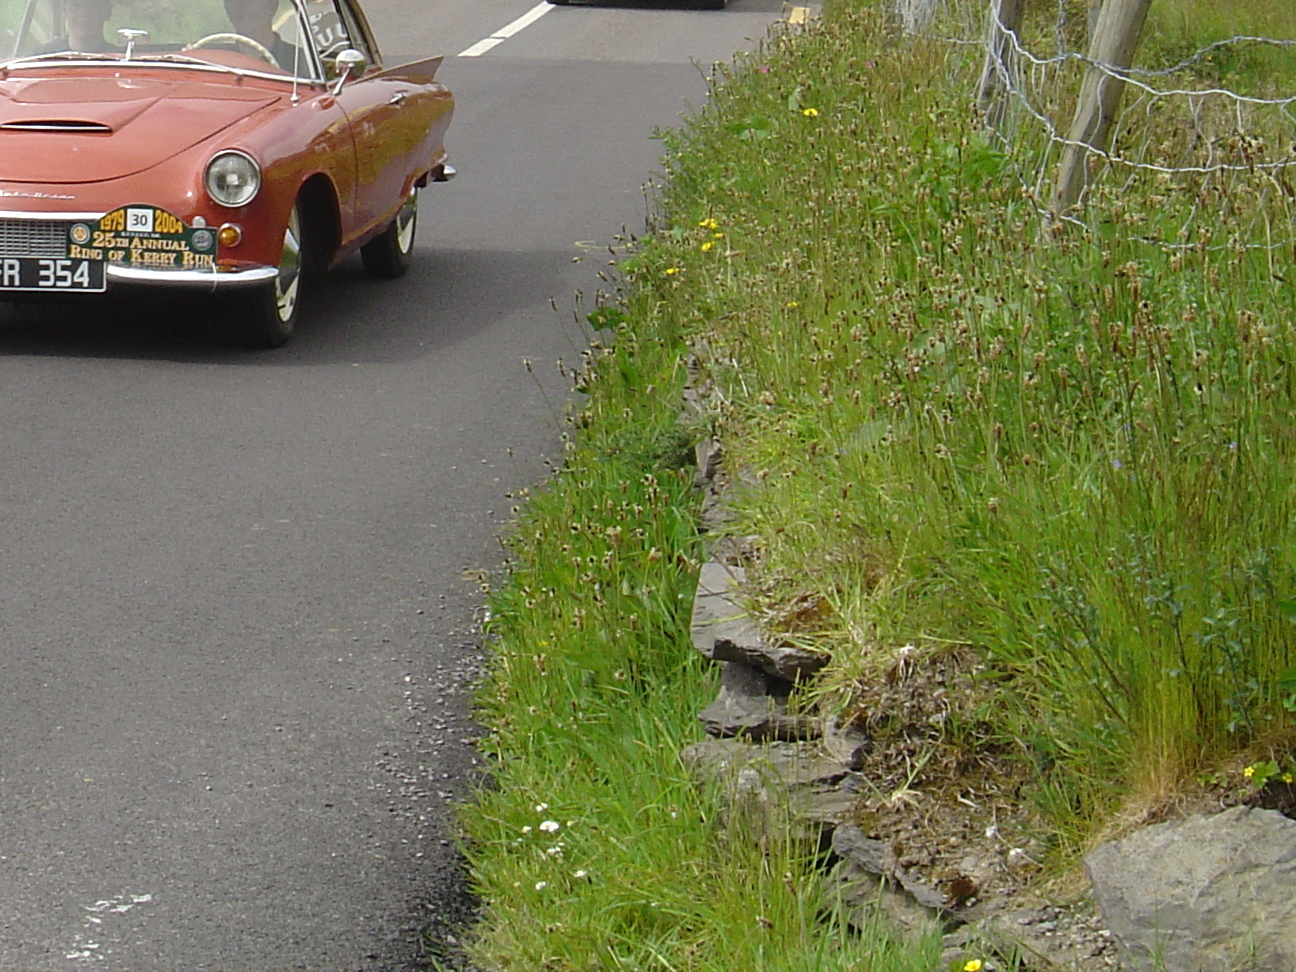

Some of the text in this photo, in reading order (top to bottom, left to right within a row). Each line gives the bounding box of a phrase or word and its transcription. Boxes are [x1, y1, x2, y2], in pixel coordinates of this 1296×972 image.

[100, 209, 183, 234] 1979 30 2004
[70, 244, 214, 266] RING OF KERRY RUN
[130, 236, 189, 251] ANNUAL
[38, 260, 90, 287] 354
